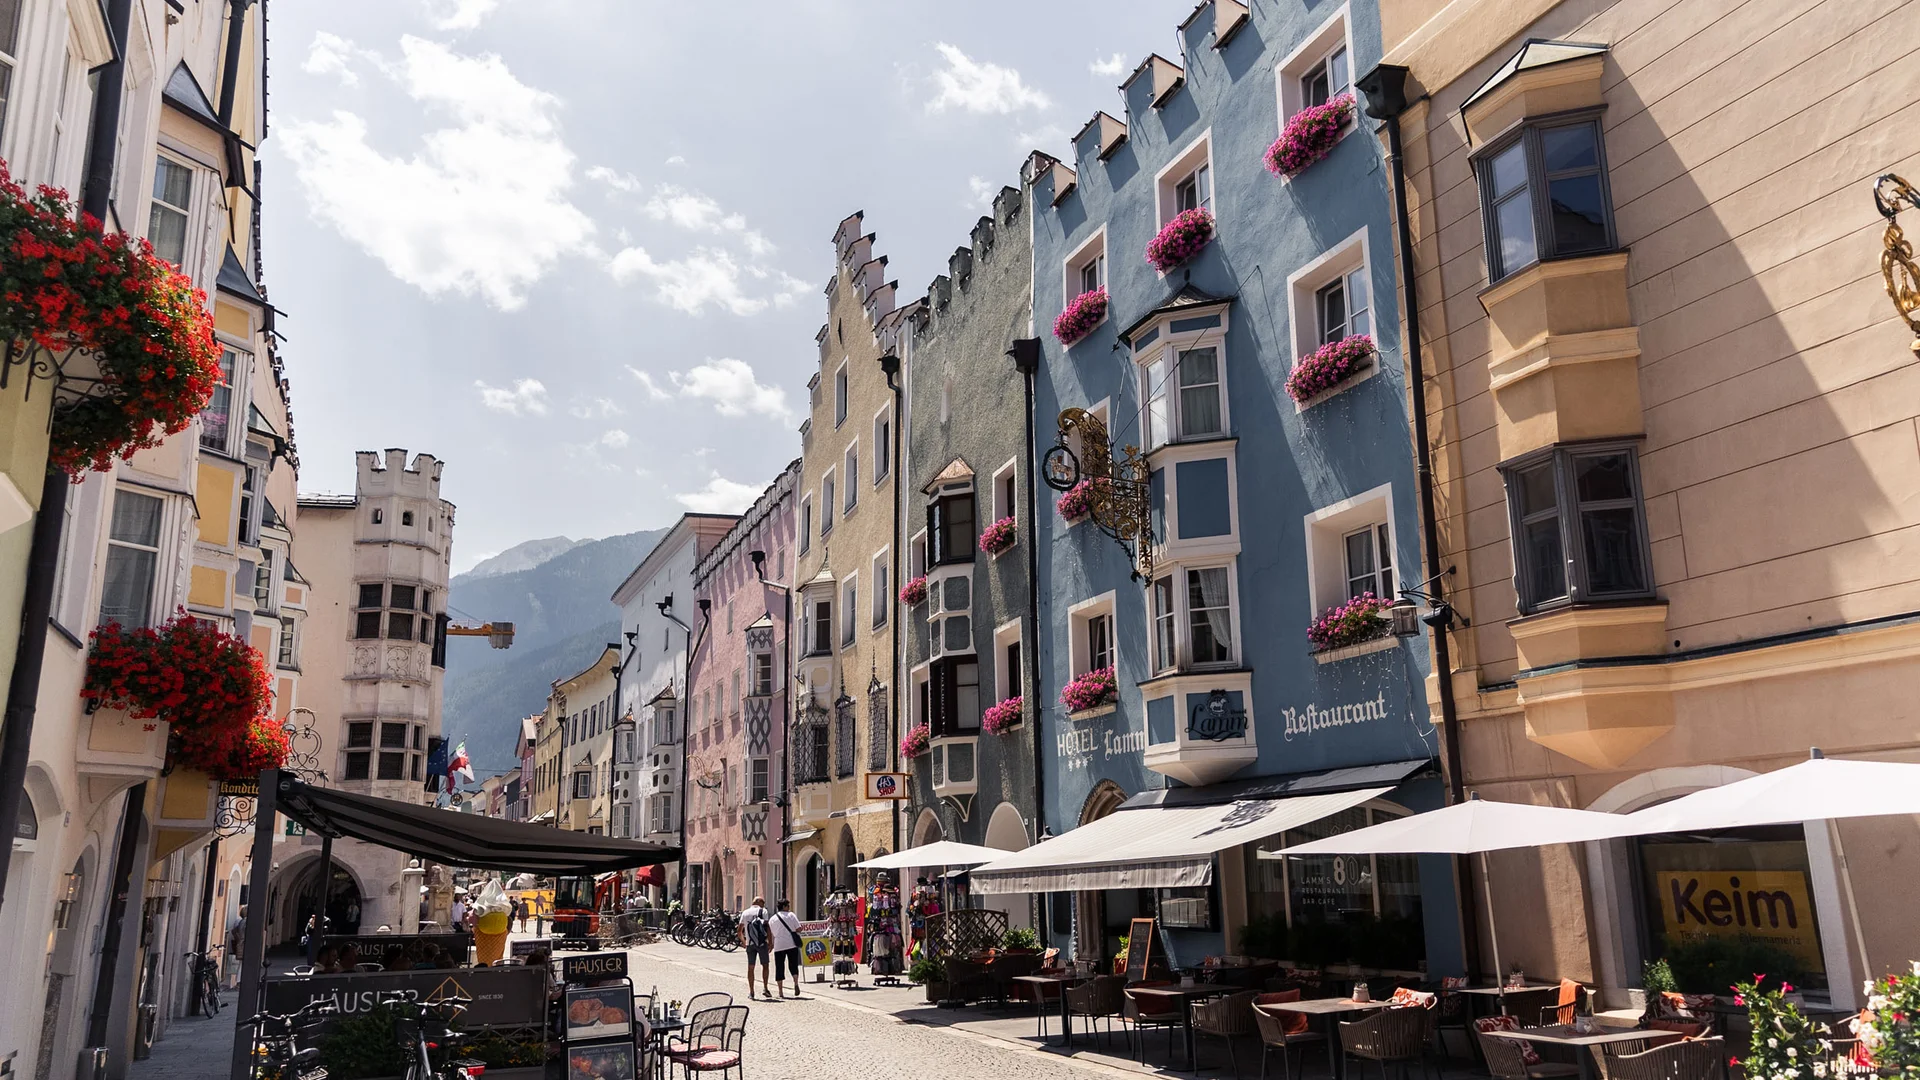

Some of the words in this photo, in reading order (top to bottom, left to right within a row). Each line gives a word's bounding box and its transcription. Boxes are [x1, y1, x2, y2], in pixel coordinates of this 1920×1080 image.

[1184, 703, 1249, 743] Lamm
[1057, 728, 1099, 757] HOTEL
[878, 786, 896, 797] SHOP
[1301, 887, 1345, 895] RESTAURANT
[1671, 876, 1798, 929] Keim
[569, 957, 622, 975] HÄUSLER
[807, 951, 828, 964] SHOP
